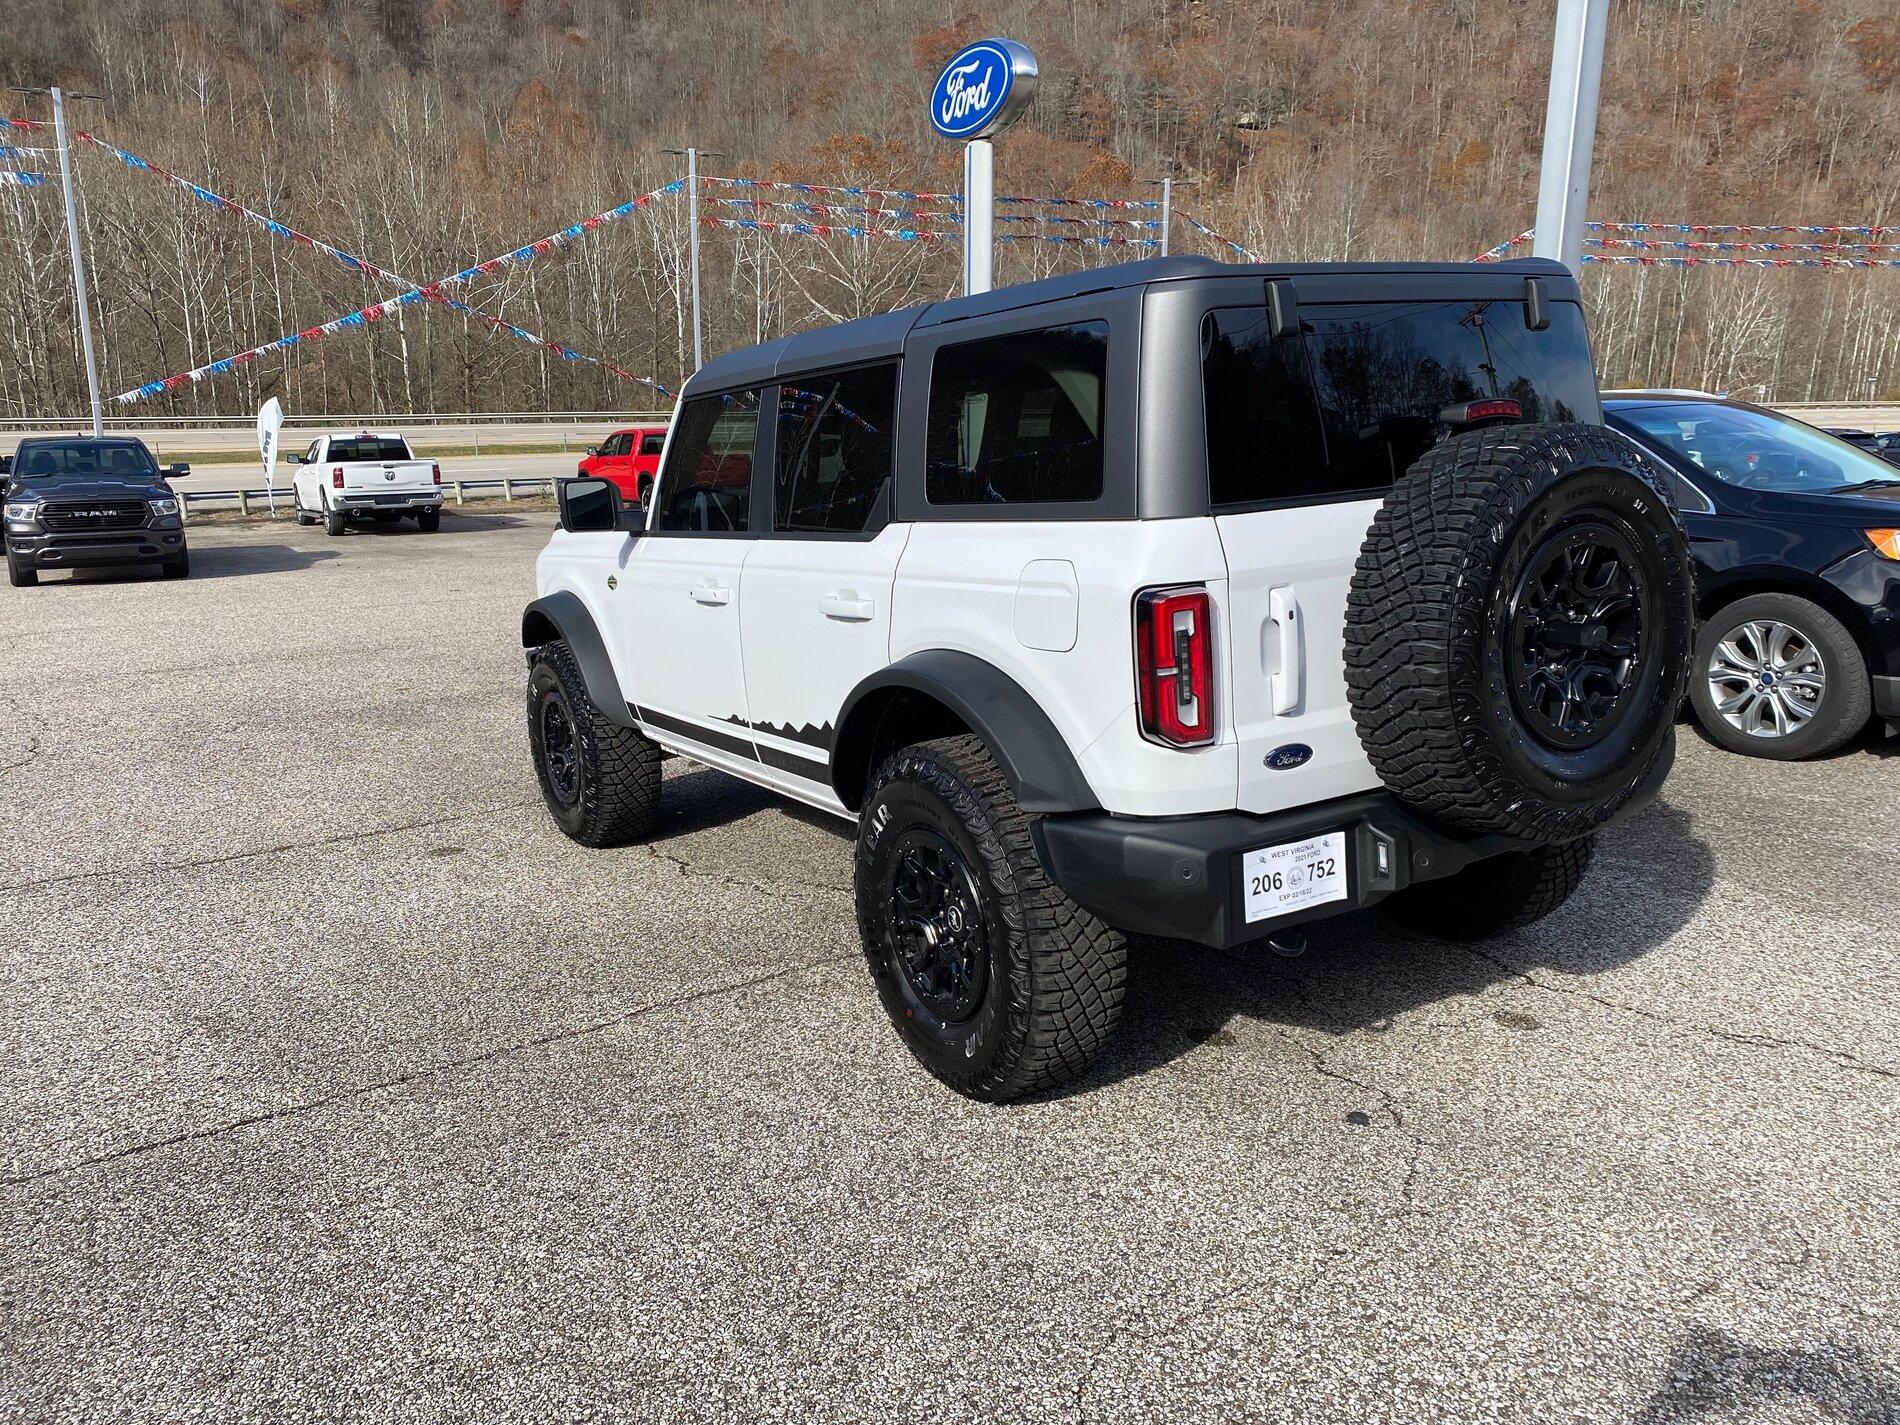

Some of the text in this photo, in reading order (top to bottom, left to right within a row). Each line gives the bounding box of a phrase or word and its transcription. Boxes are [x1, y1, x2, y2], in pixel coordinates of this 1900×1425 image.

[942, 60, 993, 123] Ford
[1277, 752, 1303, 766] Ford
[1270, 843, 1315, 859] WEST VIRGINIA
[1295, 849, 1321, 863] 2021 FORD
[1252, 872, 1283, 896] 206
[1307, 858, 1336, 882] 752
